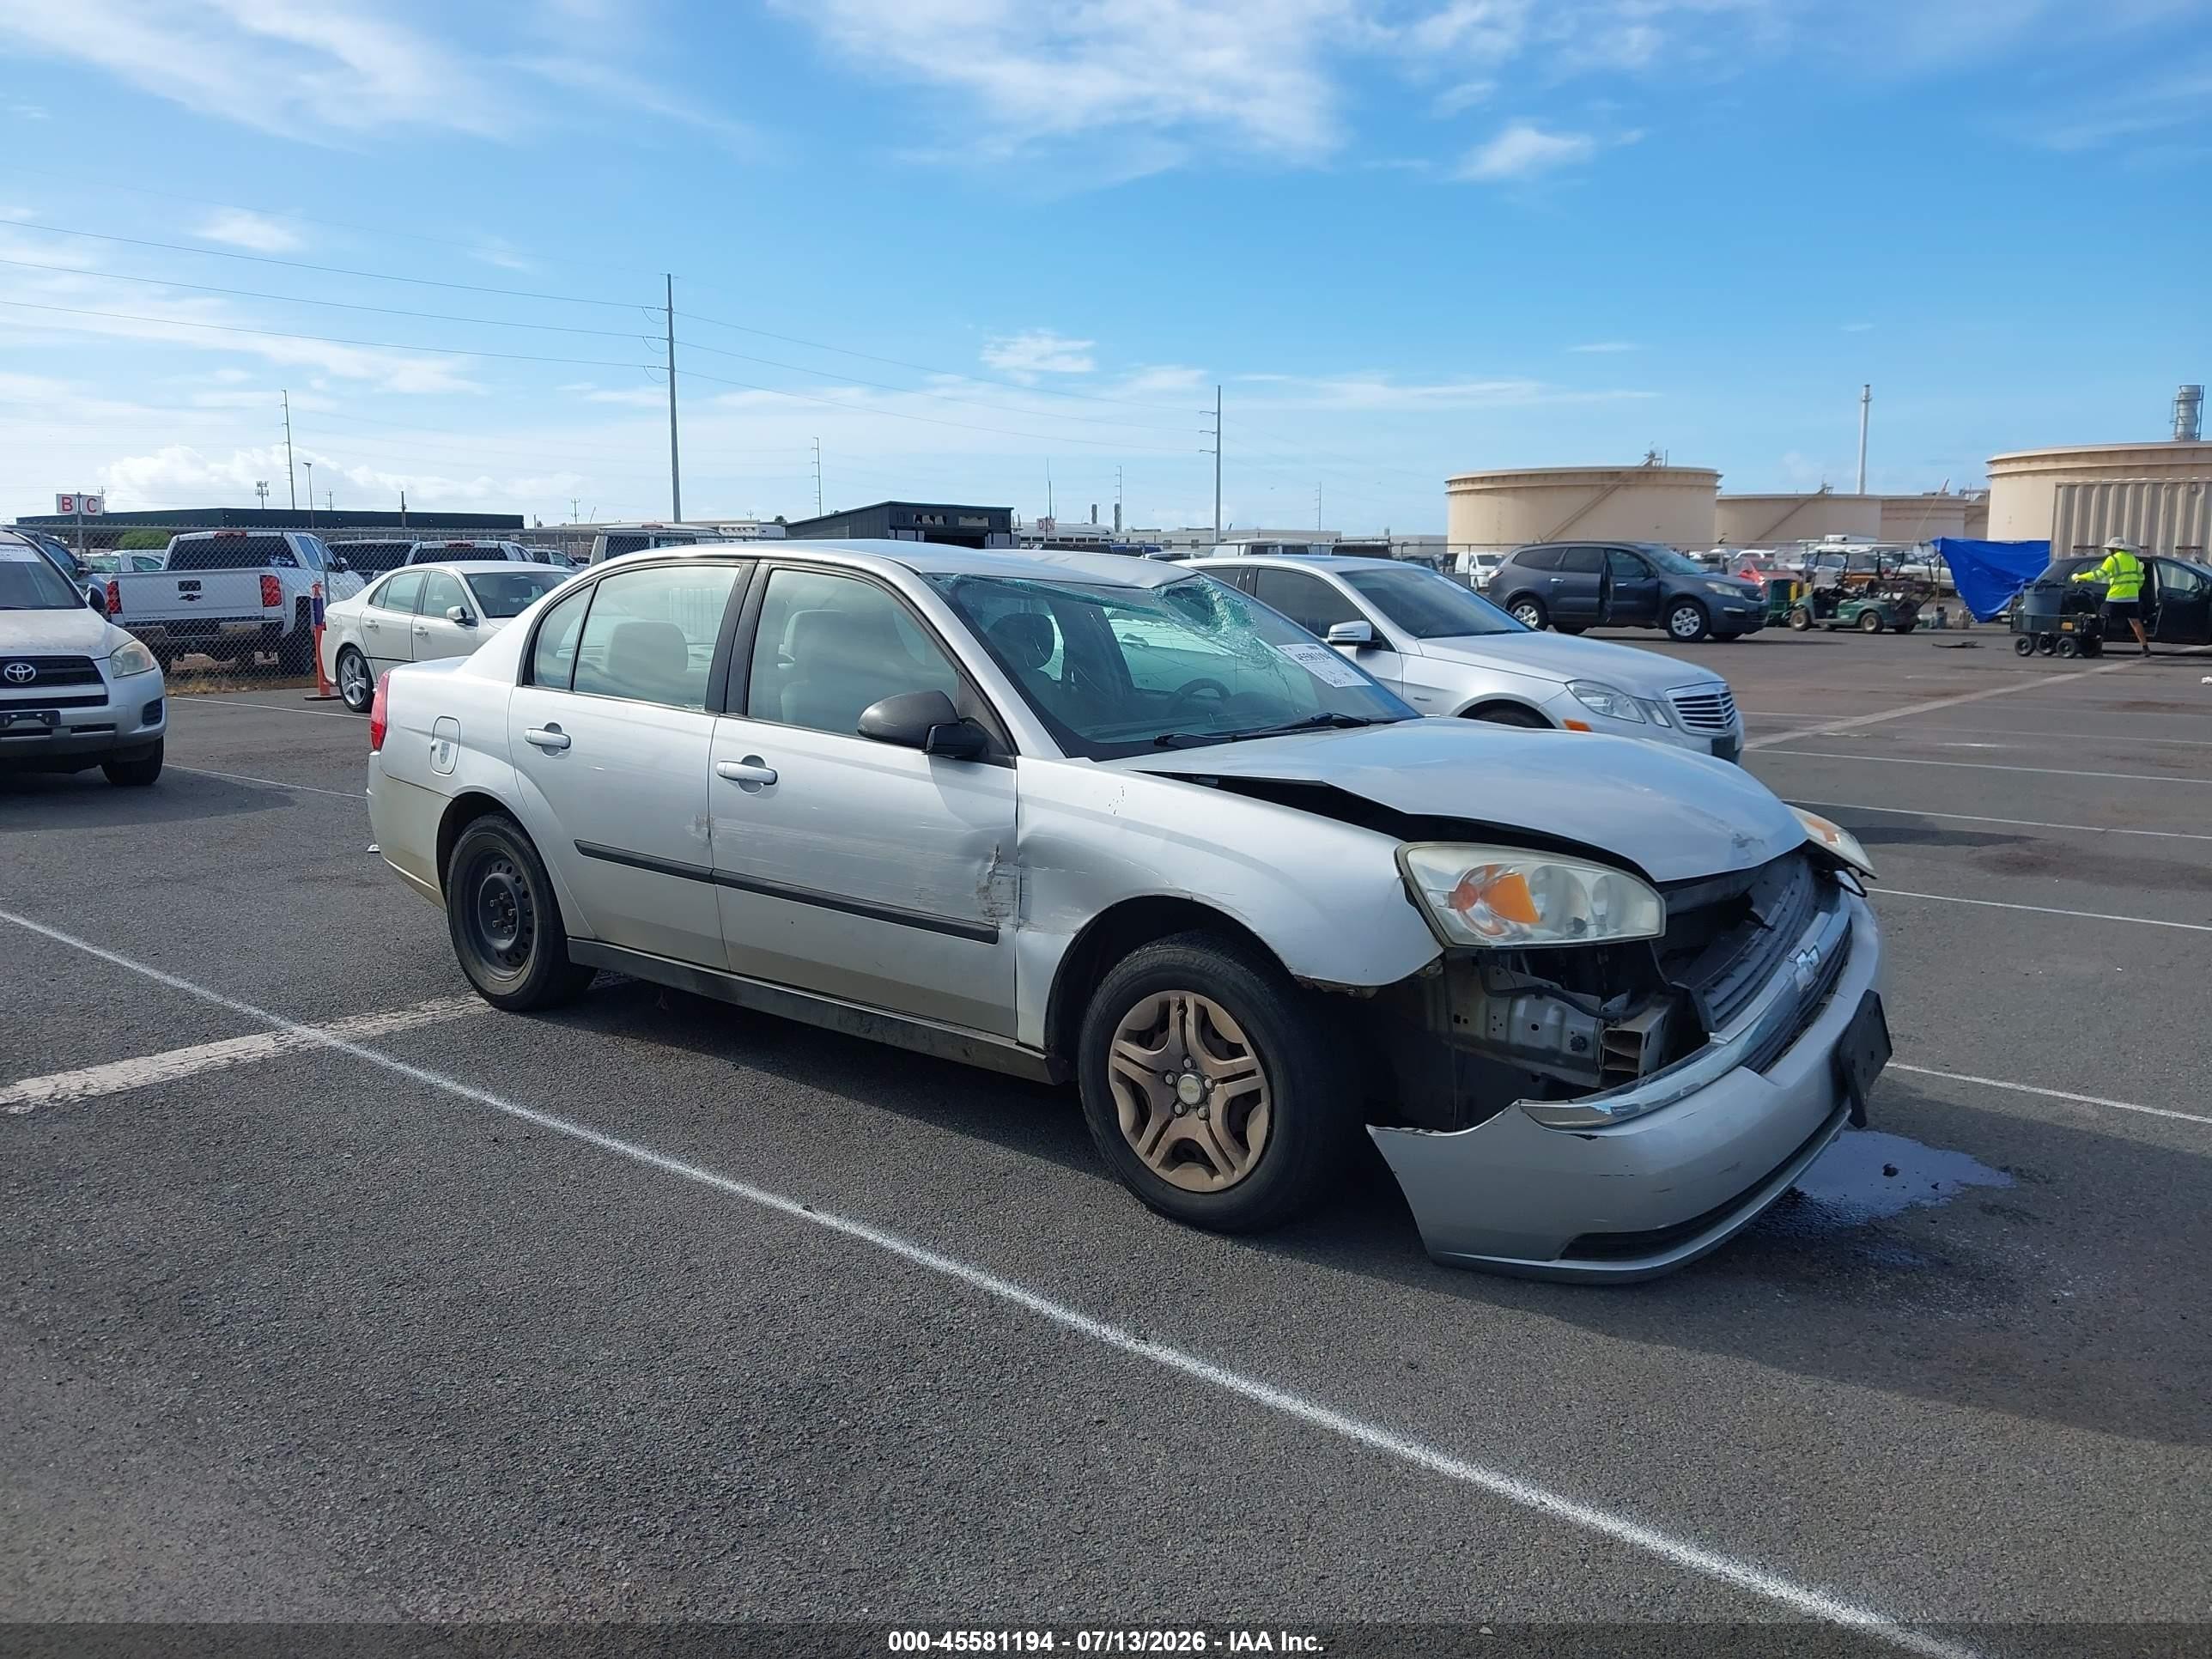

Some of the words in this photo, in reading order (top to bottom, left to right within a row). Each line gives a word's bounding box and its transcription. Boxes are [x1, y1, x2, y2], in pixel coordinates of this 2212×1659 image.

[62, 496, 74, 512] B
[87, 498, 98, 513] C
[1038, 520, 1044, 530] D
